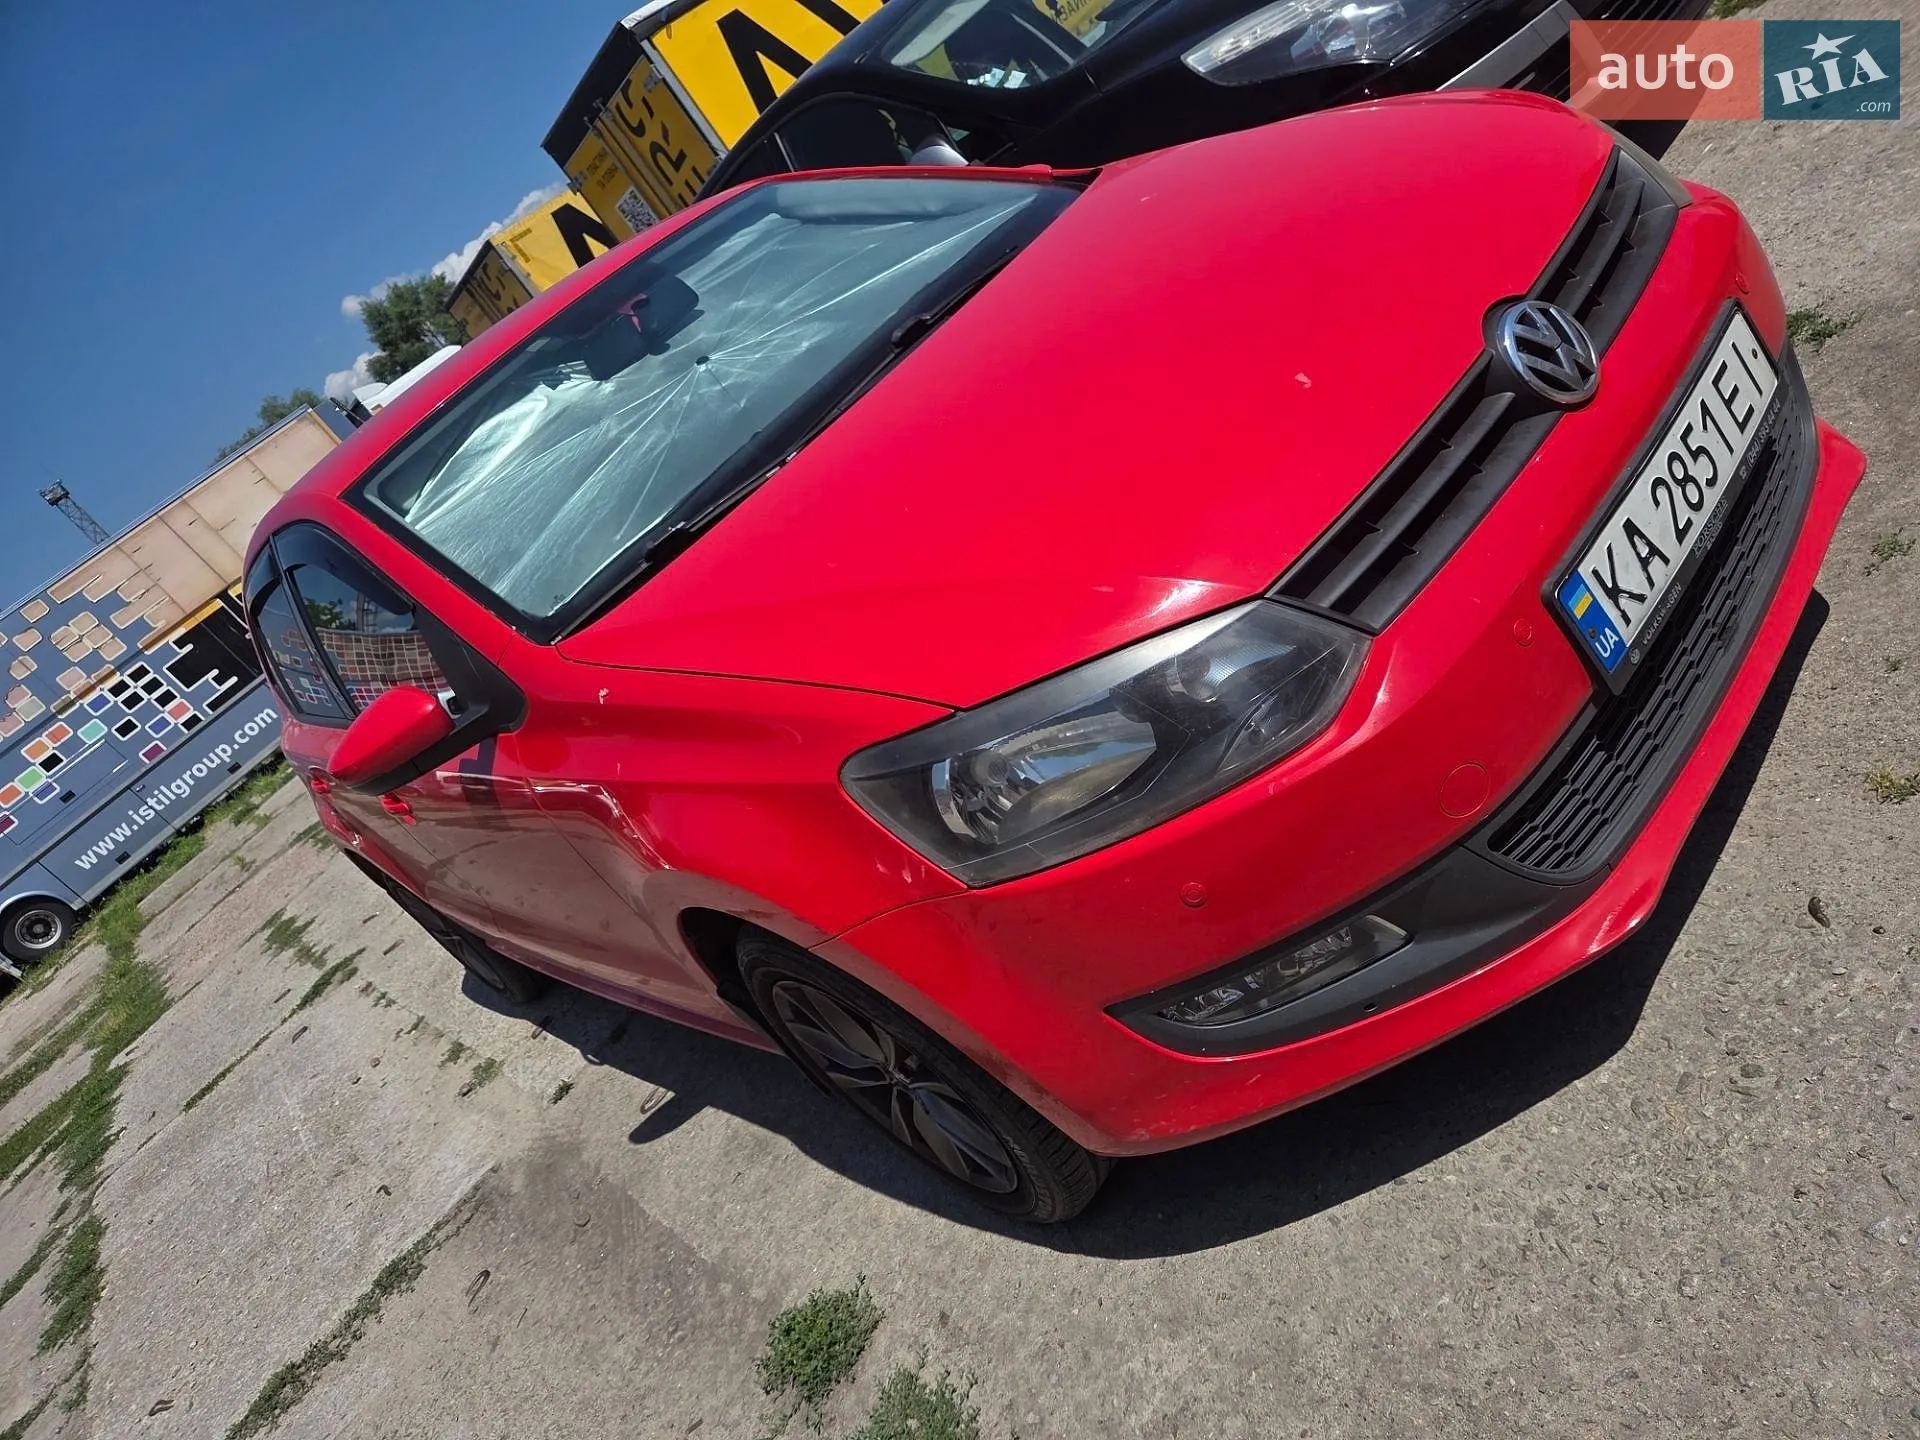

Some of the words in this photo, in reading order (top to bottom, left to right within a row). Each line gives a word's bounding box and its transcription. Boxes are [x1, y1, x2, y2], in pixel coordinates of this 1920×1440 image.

[1590, 516, 1671, 628] KA
[1650, 397, 1735, 548] 2851
[1710, 341, 1764, 435] EI
[1595, 627, 1619, 659] UA
[75, 707, 278, 870] www.istilgroup.com
